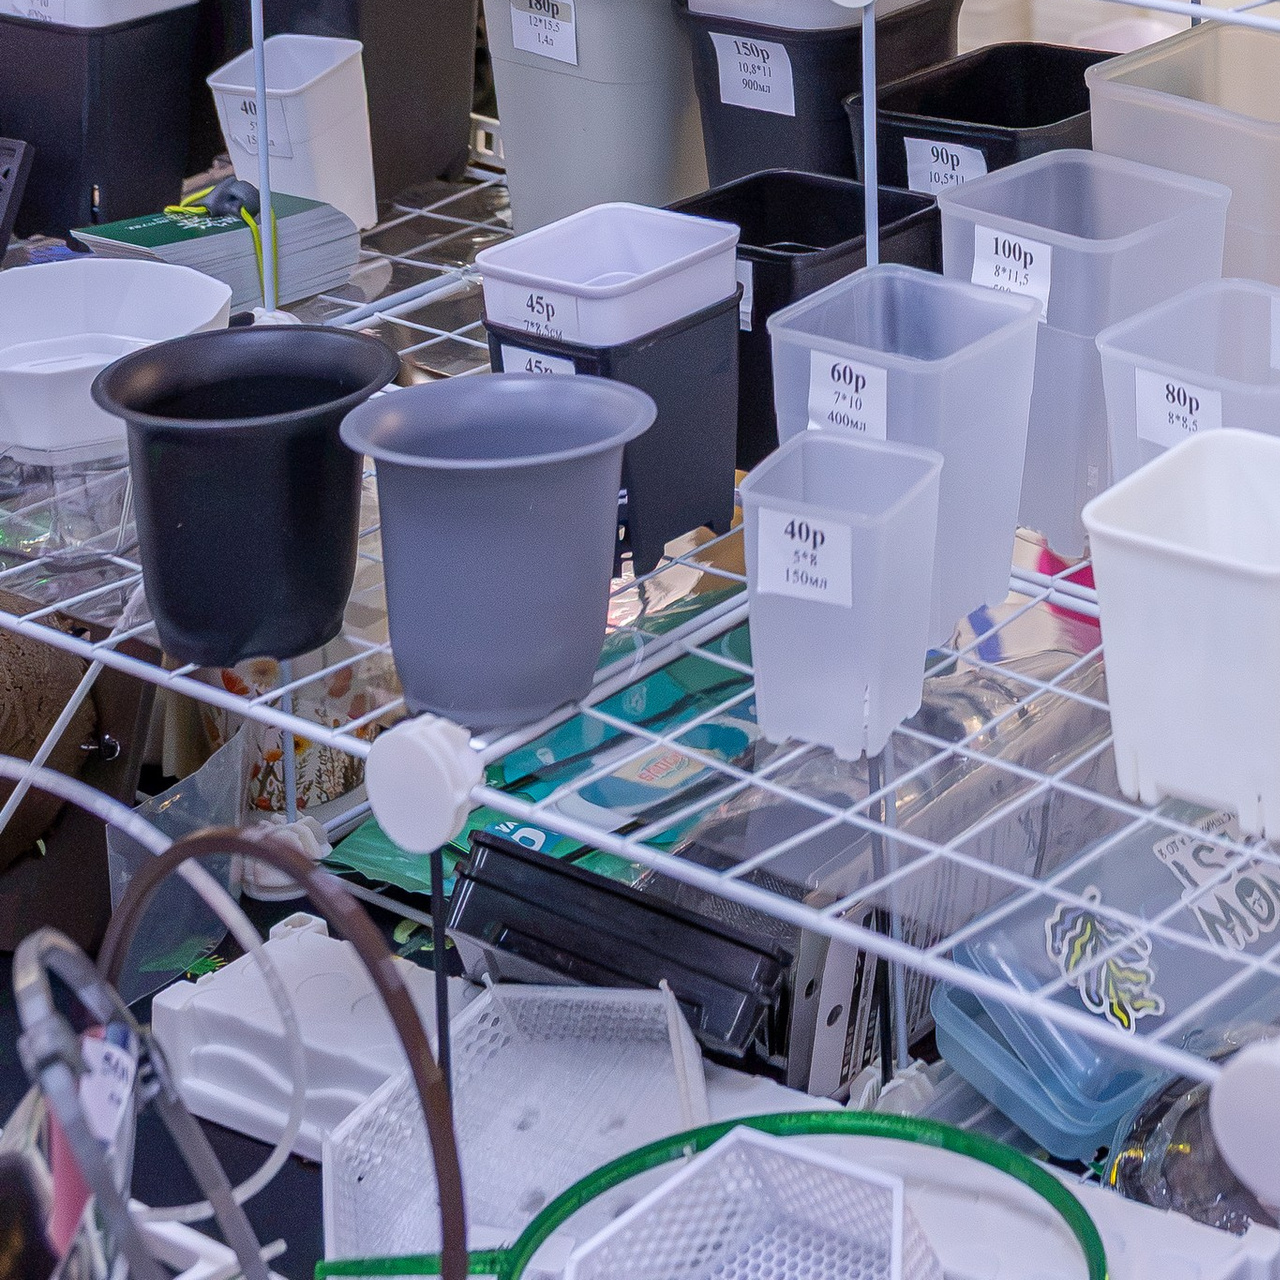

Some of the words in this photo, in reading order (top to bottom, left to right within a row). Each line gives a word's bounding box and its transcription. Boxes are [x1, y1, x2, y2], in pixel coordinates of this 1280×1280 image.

[732, 40, 770, 64] 150р
[742, 78, 771, 94] 900мл
[240, 100, 257, 116] 40
[930, 145, 961, 171] 90р
[992, 236, 1034, 270] 100р
[526, 293, 555, 321] 45р
[830, 363, 867, 393] 60р
[1164, 383, 1200, 415] 80р
[827, 411, 867, 432] 400мл
[784, 519, 825, 550] 40р
[786, 567, 828, 590] 150мл
